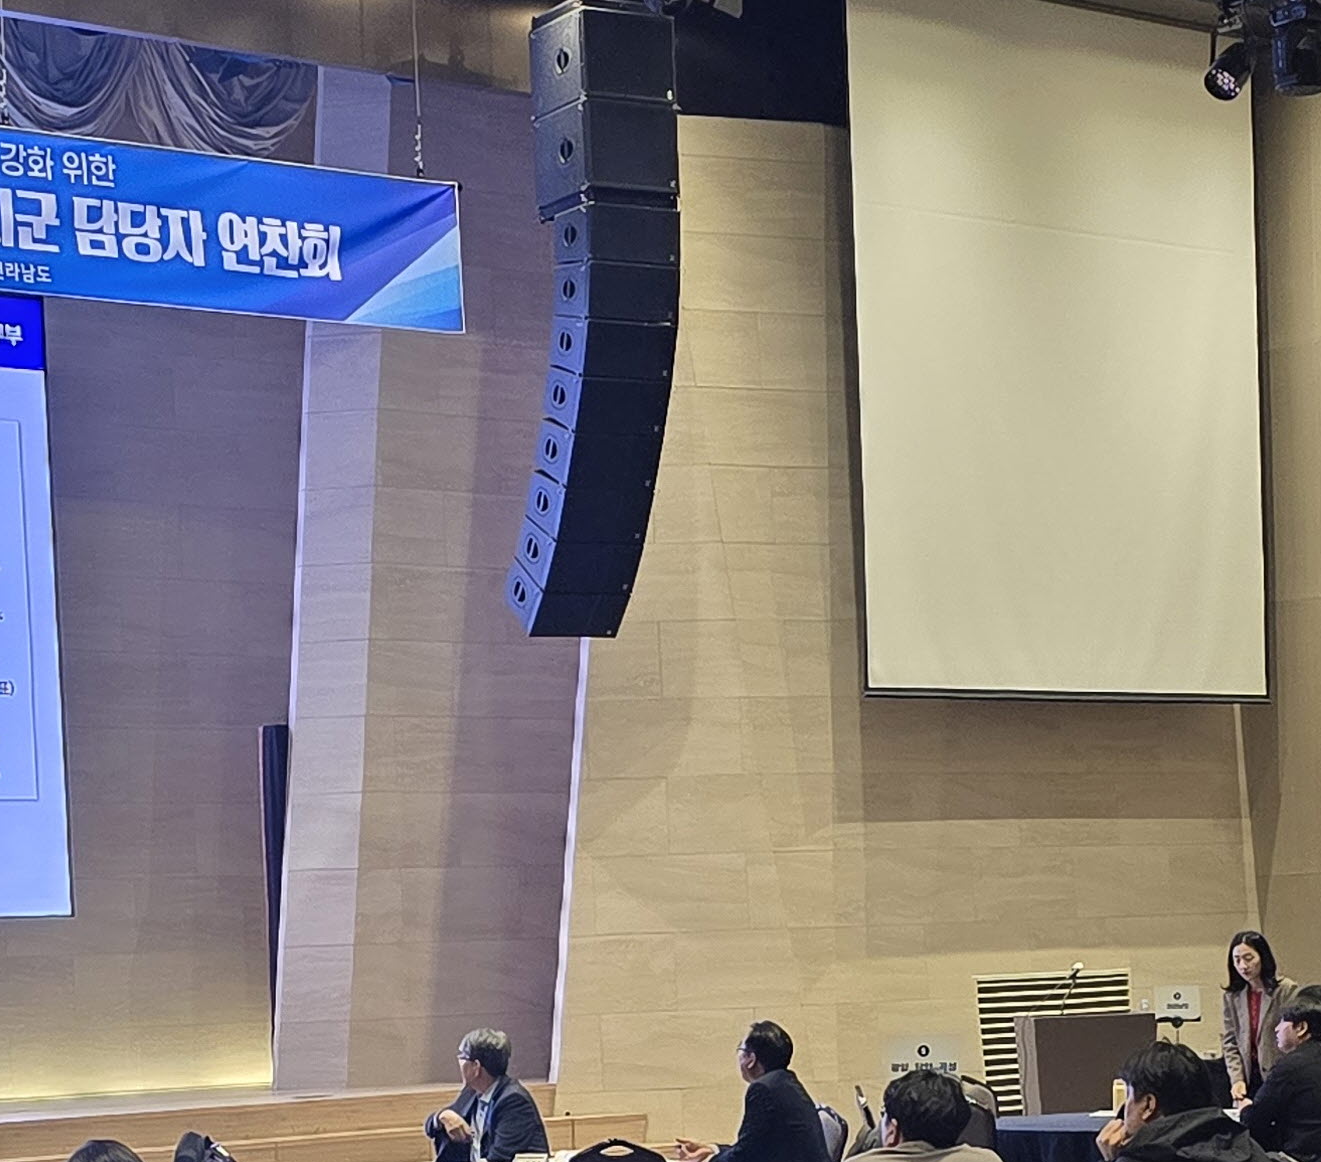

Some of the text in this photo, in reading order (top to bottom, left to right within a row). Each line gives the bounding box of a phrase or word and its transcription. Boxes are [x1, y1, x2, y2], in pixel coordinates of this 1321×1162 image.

[0, 141, 54, 181] 강화
[61, 151, 117, 188] 위한
[71, 196, 207, 267] 담당자
[216, 211, 343, 281] 연찬회
